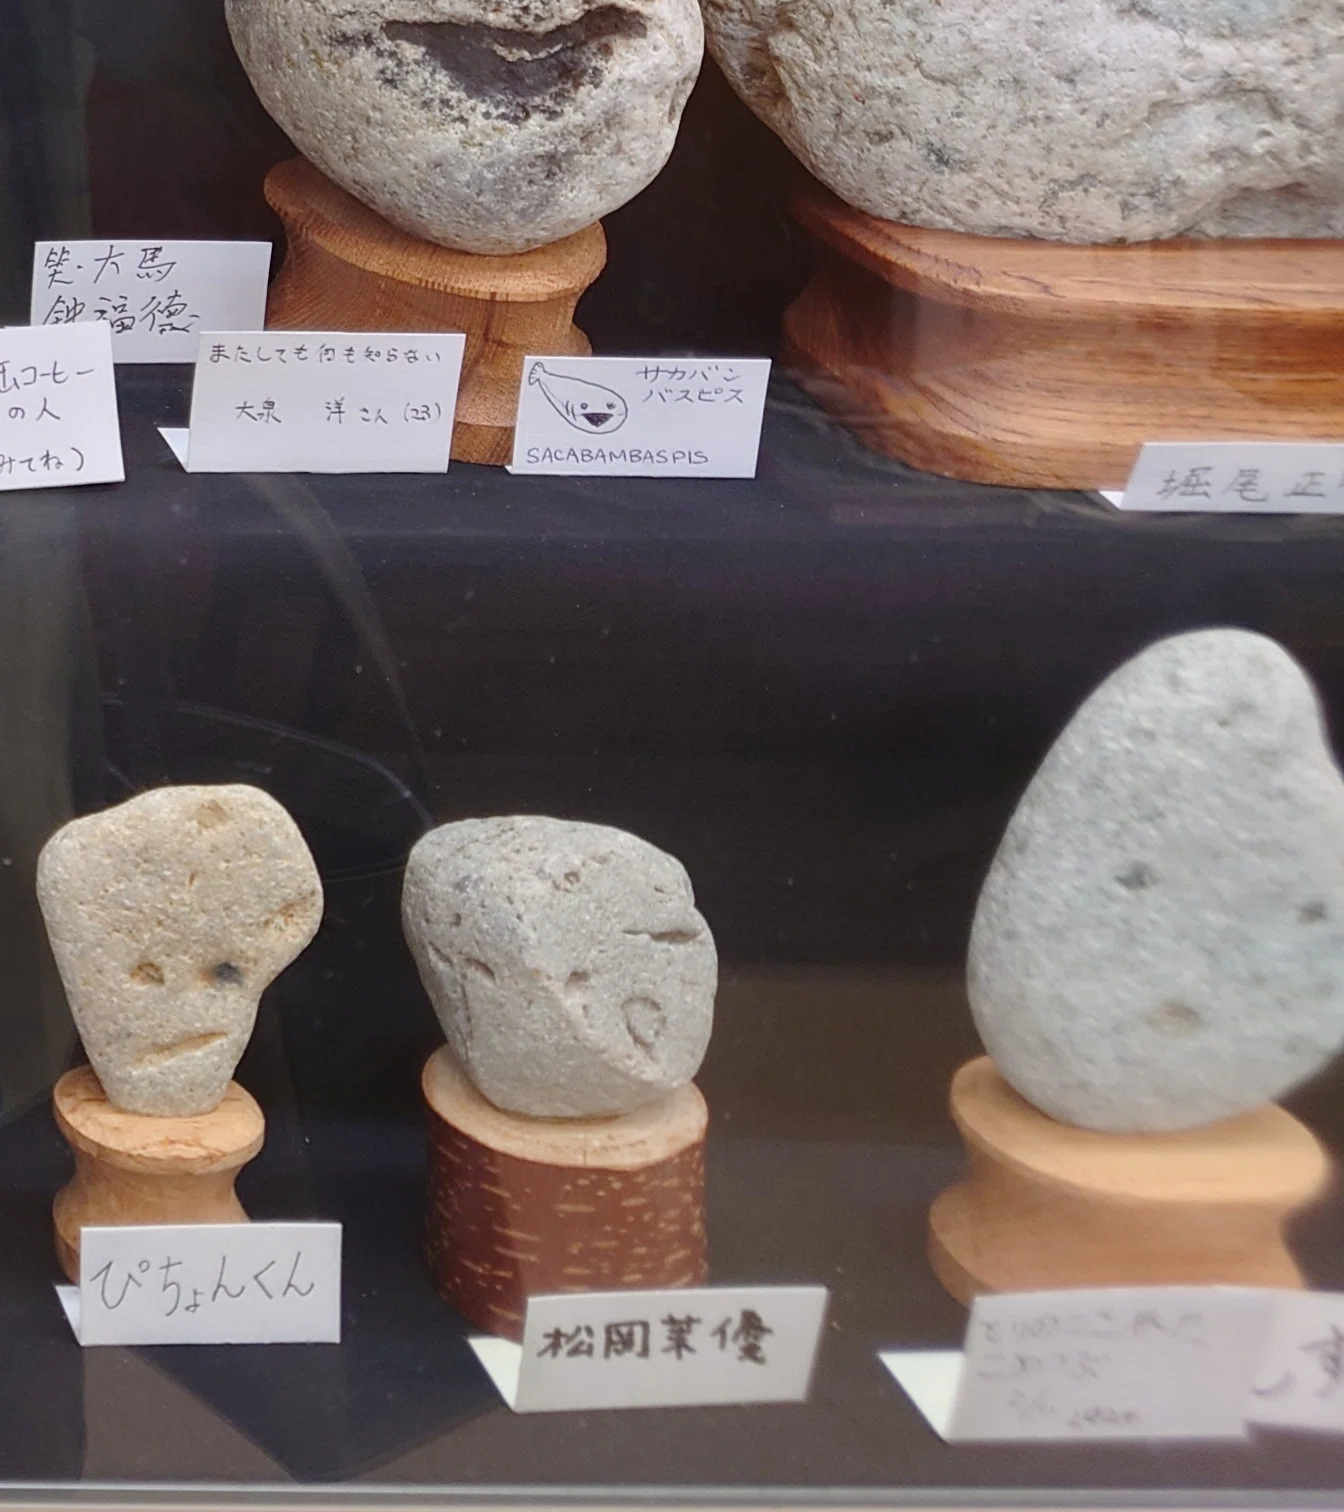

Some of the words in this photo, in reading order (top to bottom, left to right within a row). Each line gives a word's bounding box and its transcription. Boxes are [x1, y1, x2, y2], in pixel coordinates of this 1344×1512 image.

[209, 343, 440, 364] またしても何も知らない
[636, 365, 740, 383] サカバン
[642, 388, 743, 404] バスピス
[8, 398, 61, 421] の人
[235, 399, 281, 424] 大泉
[527, 447, 709, 465] SACABAMBASPIS
[89, 1251, 314, 1317] ぴちょんくん
